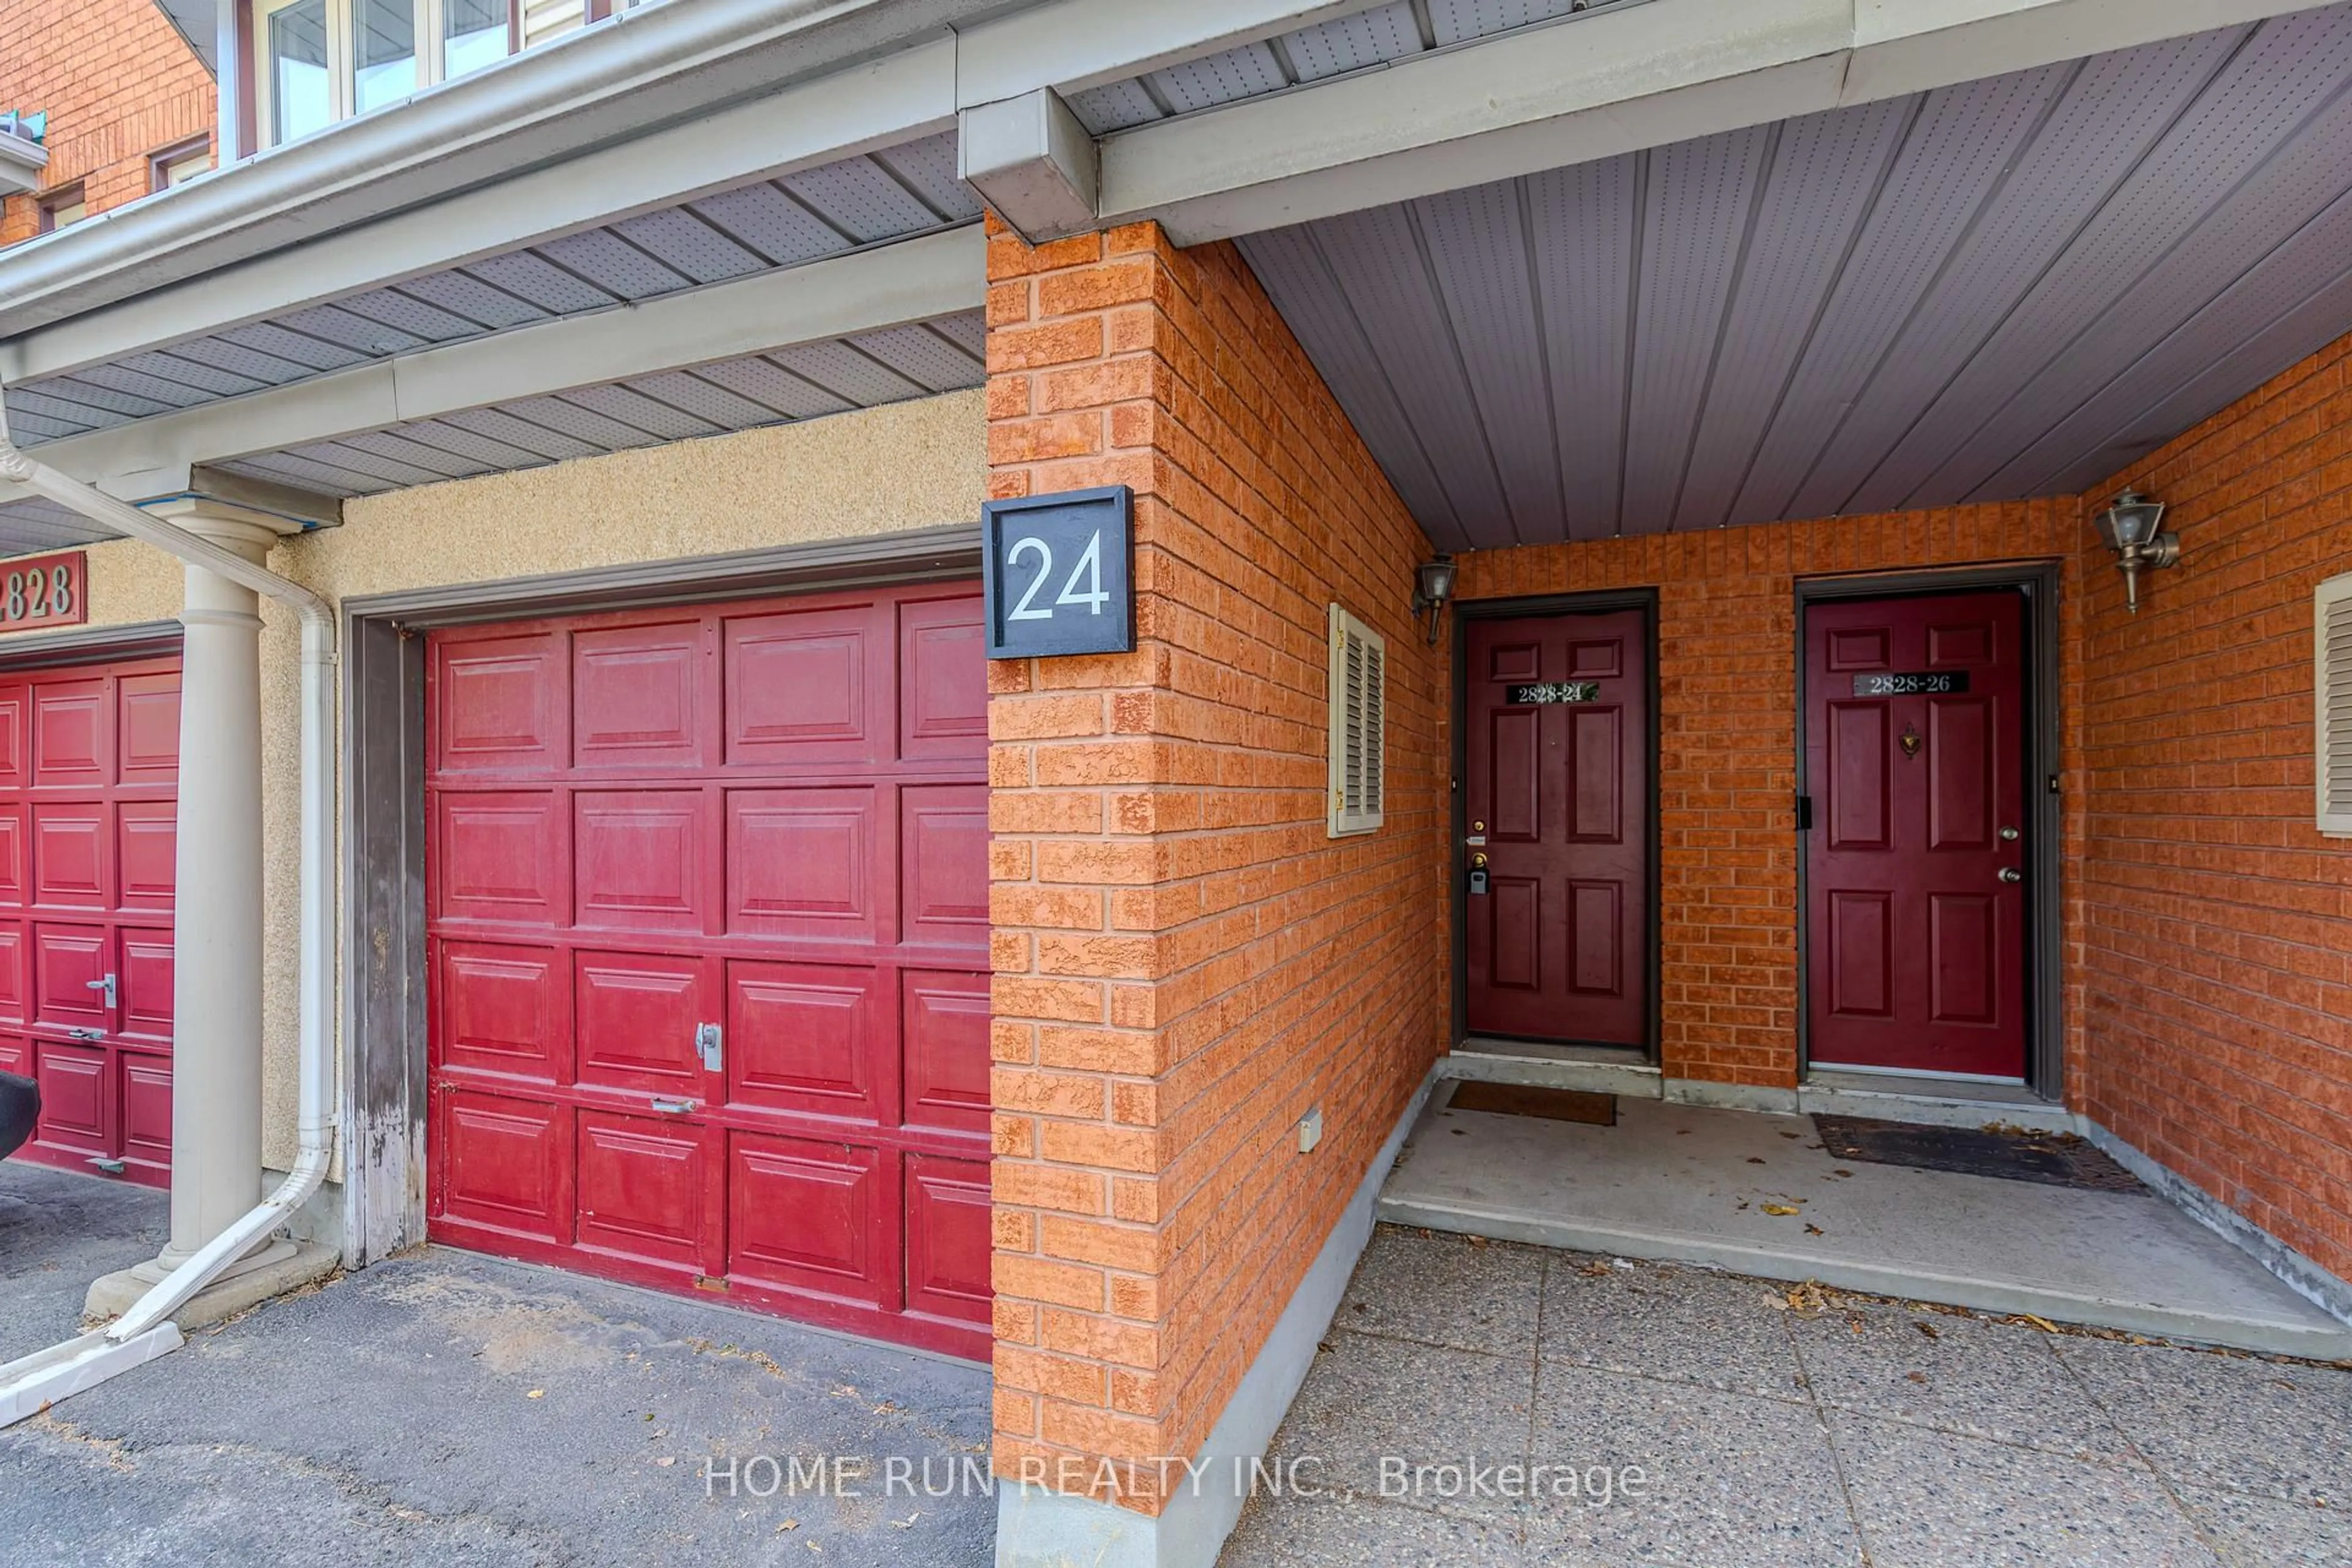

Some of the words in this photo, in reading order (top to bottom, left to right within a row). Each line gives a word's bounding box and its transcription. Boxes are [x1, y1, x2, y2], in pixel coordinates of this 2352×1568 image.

[0, 565, 70, 620] 828
[1008, 528, 1110, 621] 24
[1518, 685, 1582, 703] 2828-24
[1870, 675, 1950, 693] 2828-26
